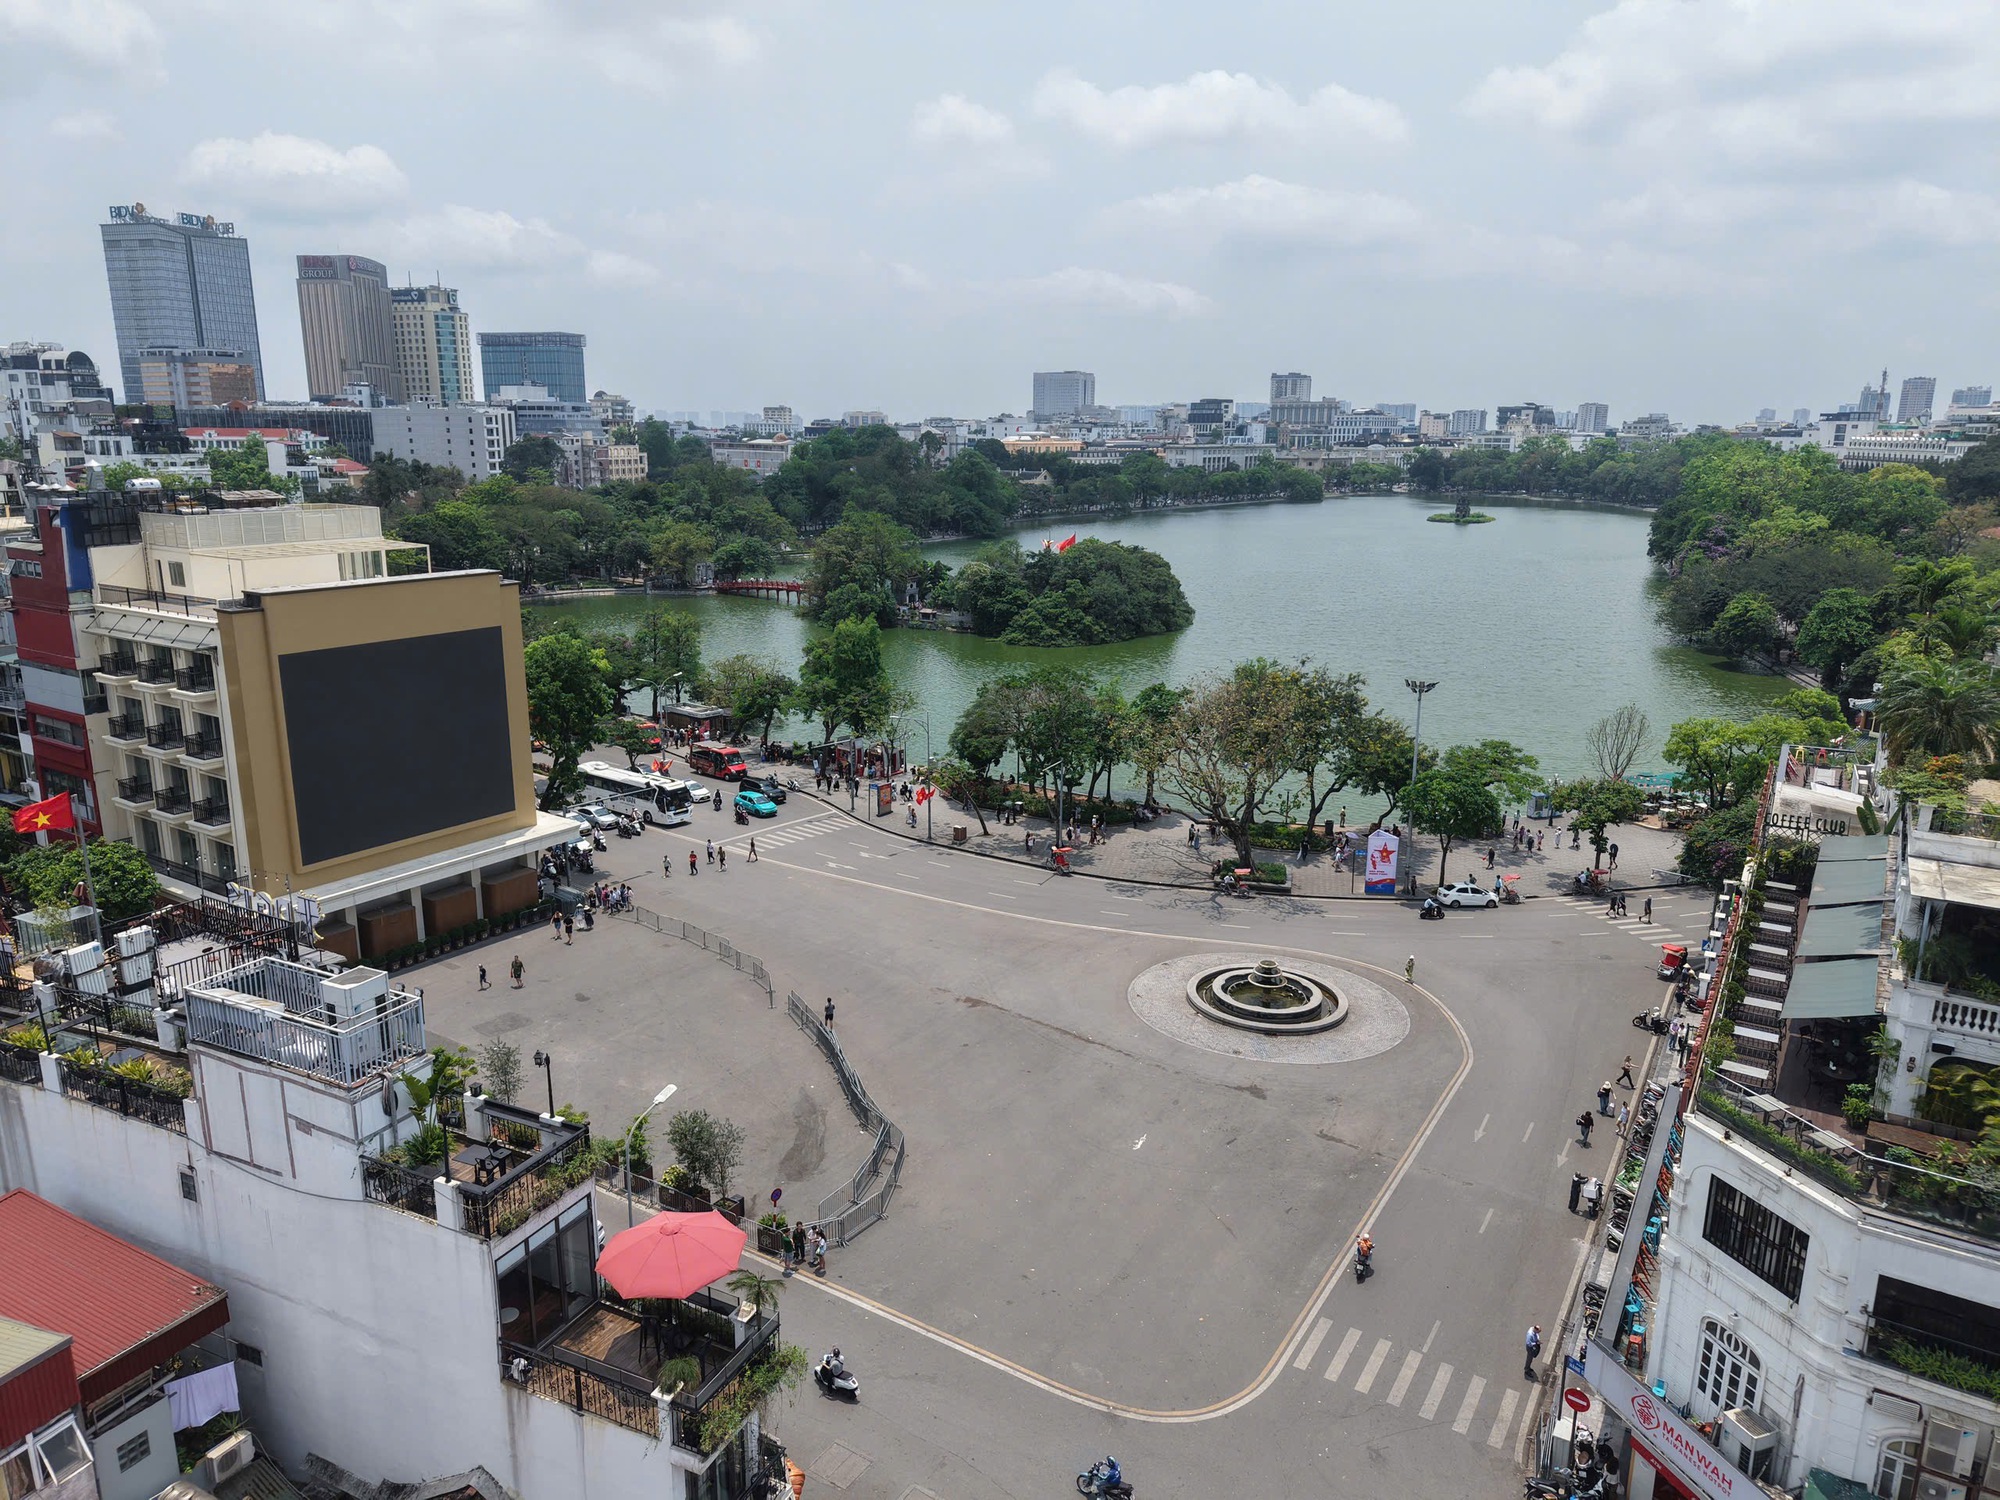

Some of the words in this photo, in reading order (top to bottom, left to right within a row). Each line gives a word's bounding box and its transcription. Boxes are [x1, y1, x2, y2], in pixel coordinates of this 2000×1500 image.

[109, 205, 135, 219] BIDV
[181, 212, 206, 227] BIDV
[301, 269, 334, 278] GROUP
[1816, 818, 1846, 834] CLUB
[1662, 1420, 1733, 1490] MANWAH
[1650, 1458, 1662, 1469] ATM
[1661, 1432, 1701, 1472] TAIWANESE
[1702, 1471, 1732, 1497] HOTPOT
